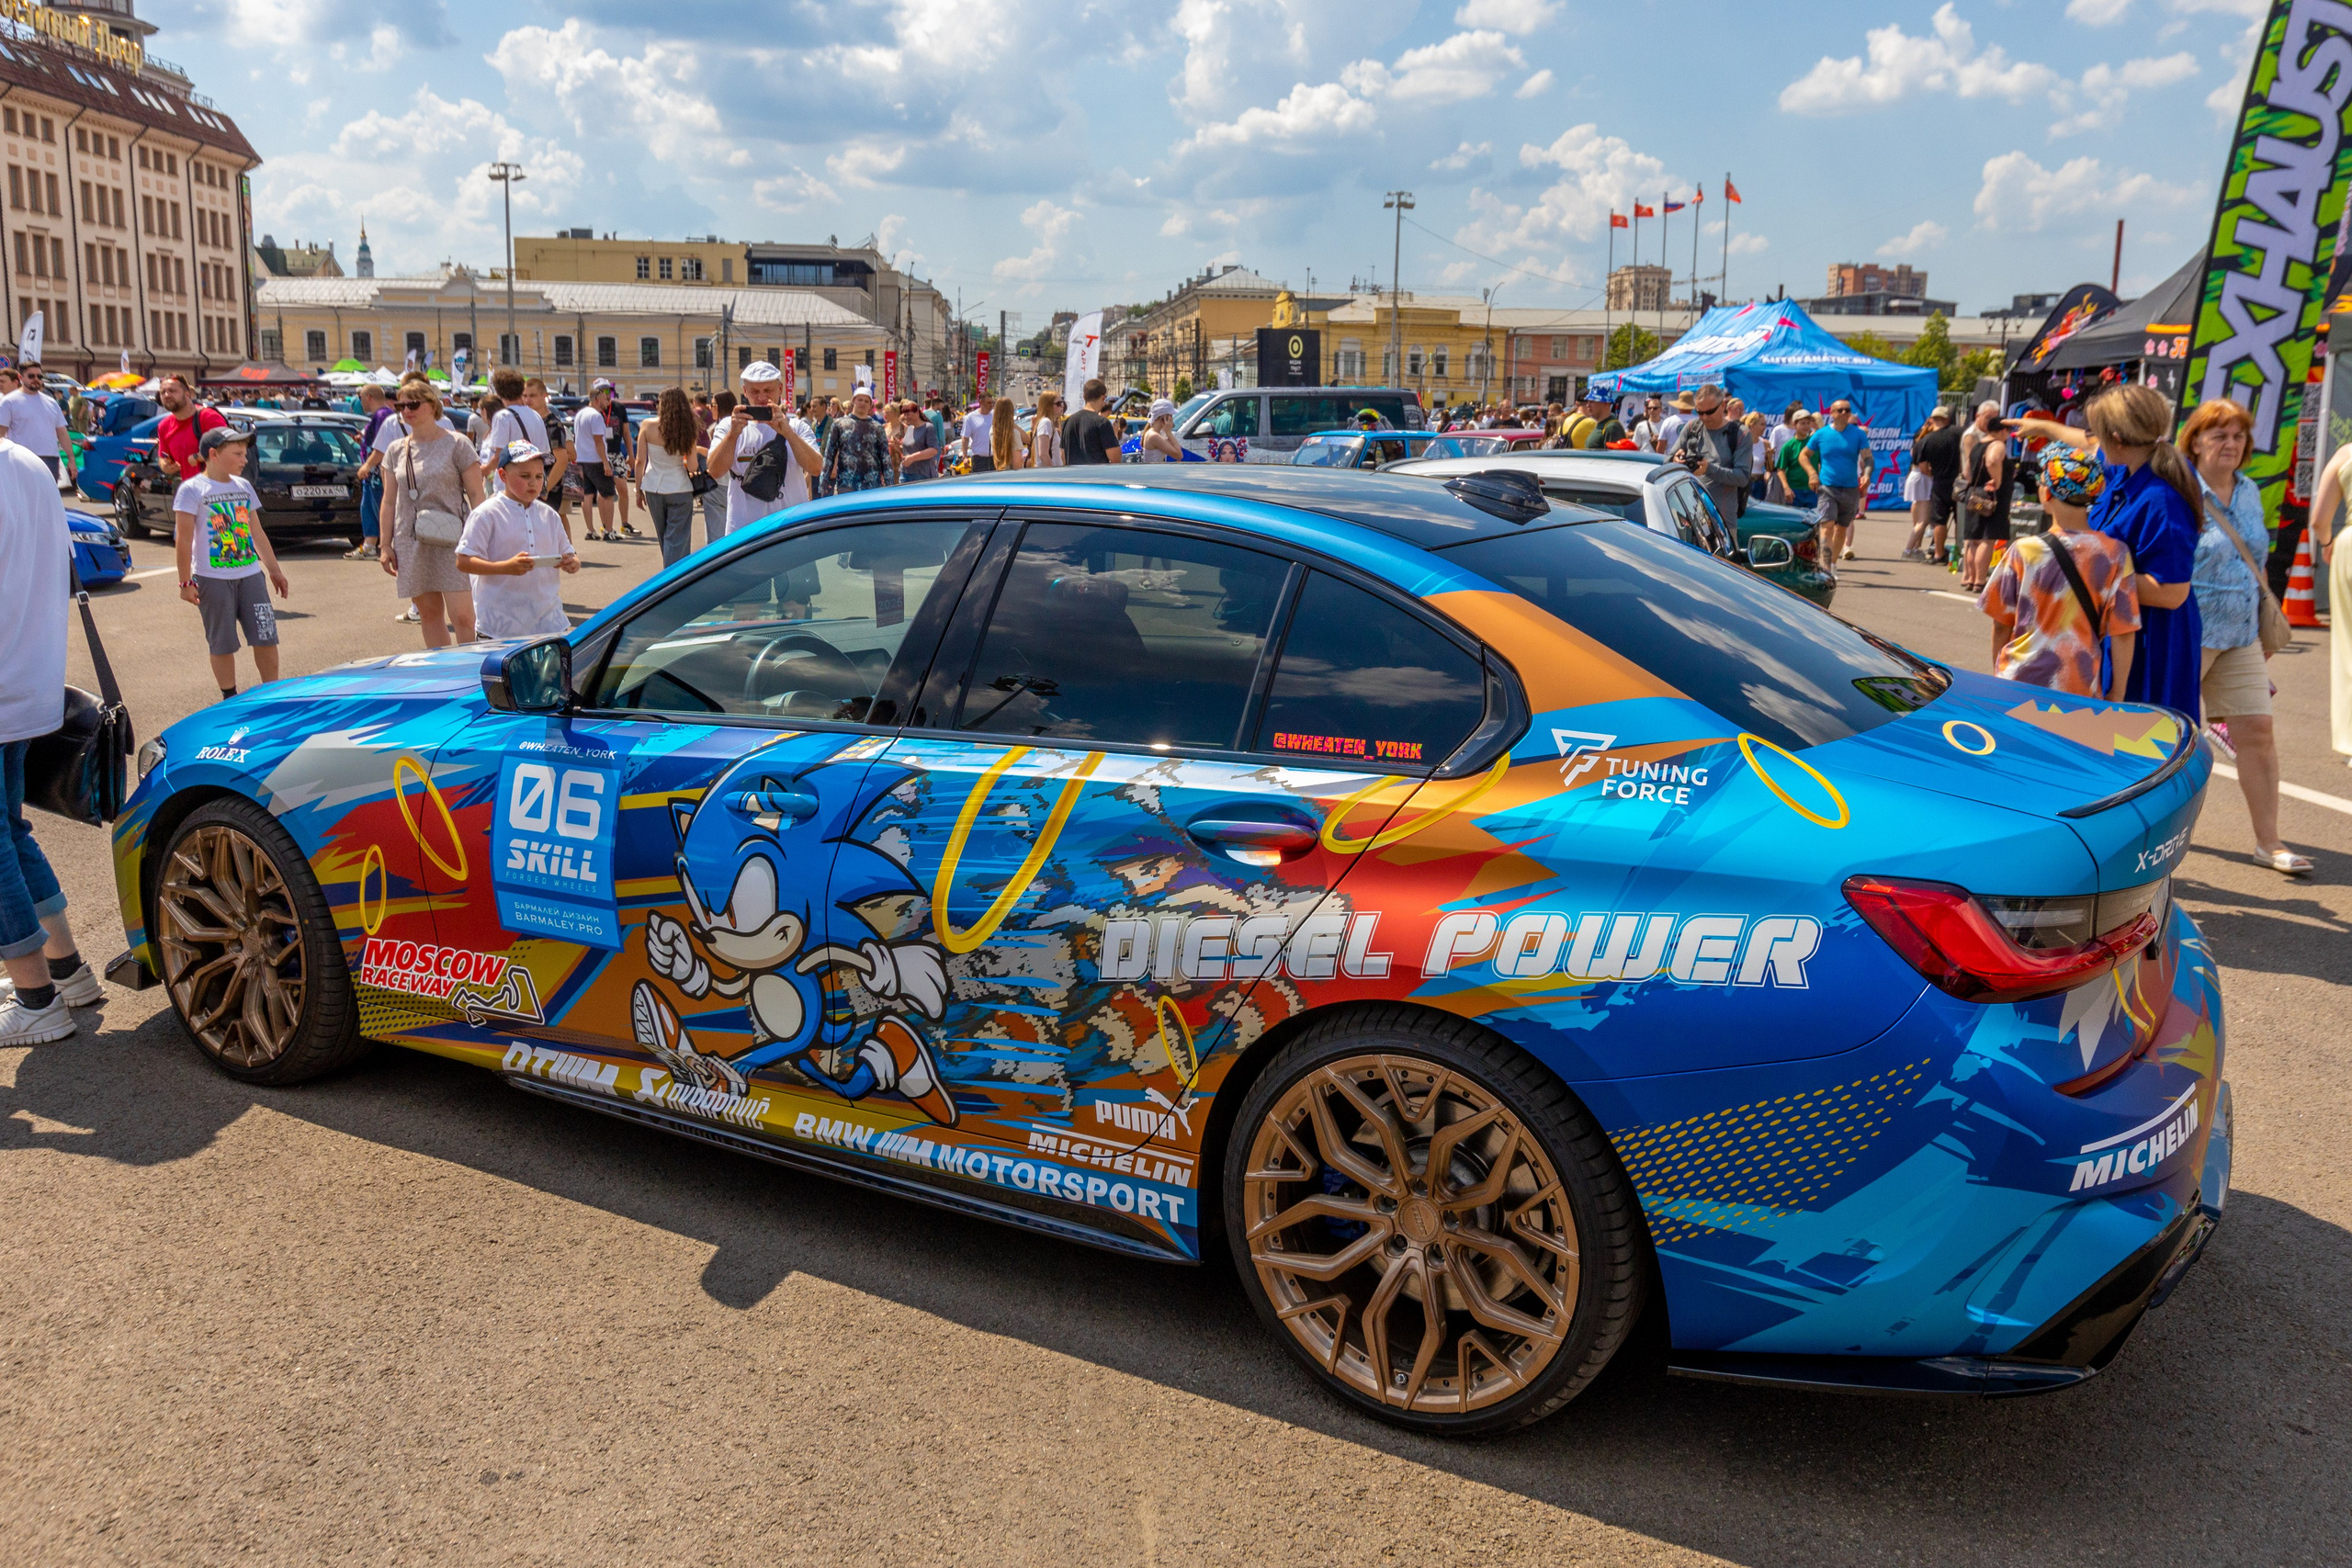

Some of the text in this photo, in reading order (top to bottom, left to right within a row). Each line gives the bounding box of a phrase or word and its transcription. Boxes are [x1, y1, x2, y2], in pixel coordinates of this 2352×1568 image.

[0, 0, 144, 77] остиный Двор
[195, 746, 251, 763] ROLEX
[519, 740, 617, 761] @WHEATEN_YORK
[1272, 732, 1423, 760] @WHEATEN_YORK
[1601, 779, 1691, 805] FORCE
[1606, 757, 1709, 786] TUNING
[509, 762, 605, 840] 06
[506, 839, 597, 882] SKILL
[2134, 826, 2188, 874] X-DRIVE
[505, 871, 597, 893] FORGED WHEELS
[514, 902, 600, 924] БАРМАЛЕЙ ДИЗАЙН
[515, 911, 603, 936] BARMALEY.PRO
[363, 938, 509, 988] MOSCOW
[1098, 910, 1824, 989] DIESEL POWER
[360, 966, 458, 999] RACEWAY
[1094, 1099, 1176, 1141] PUMA
[1027, 1132, 1192, 1188] MICHELIN
[2069, 1097, 2199, 1192] MICHELIN
[793, 1111, 875, 1153] BMW
[937, 1145, 1185, 1224] MOTORSPORT
